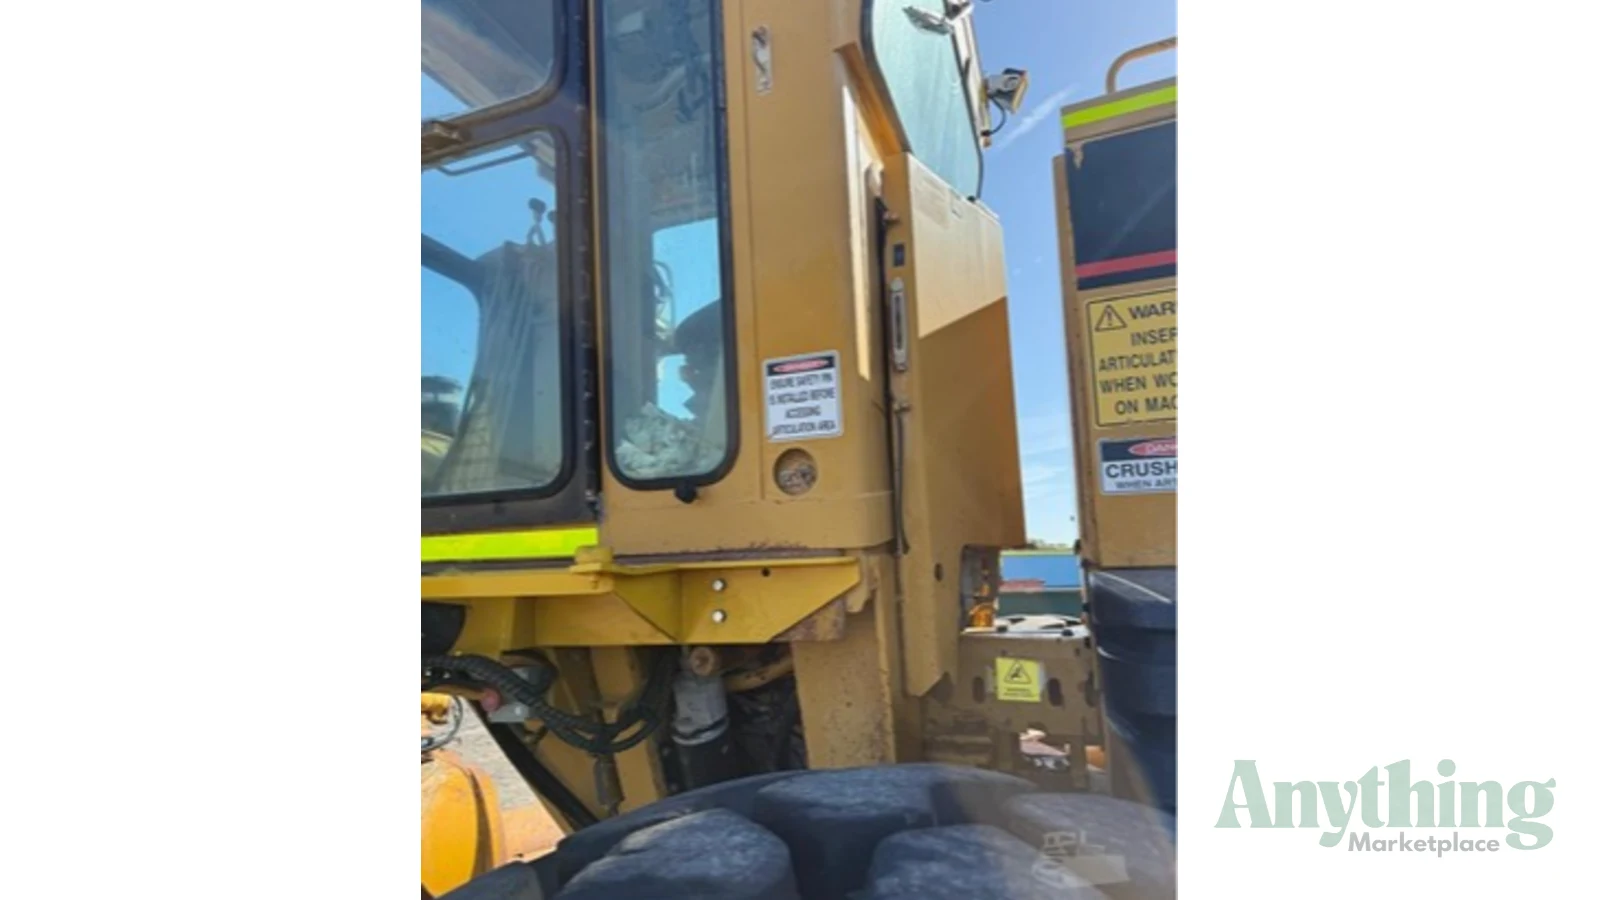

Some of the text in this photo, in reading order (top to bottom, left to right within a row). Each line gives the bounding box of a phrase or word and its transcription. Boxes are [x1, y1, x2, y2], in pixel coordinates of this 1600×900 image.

[1128, 301, 1176, 320] WAR
[1099, 349, 1176, 372] ARTICULAT
[1100, 376, 1147, 393] WHEN
[1115, 398, 1138, 415] ON
[1116, 480, 1152, 489] WHEN
